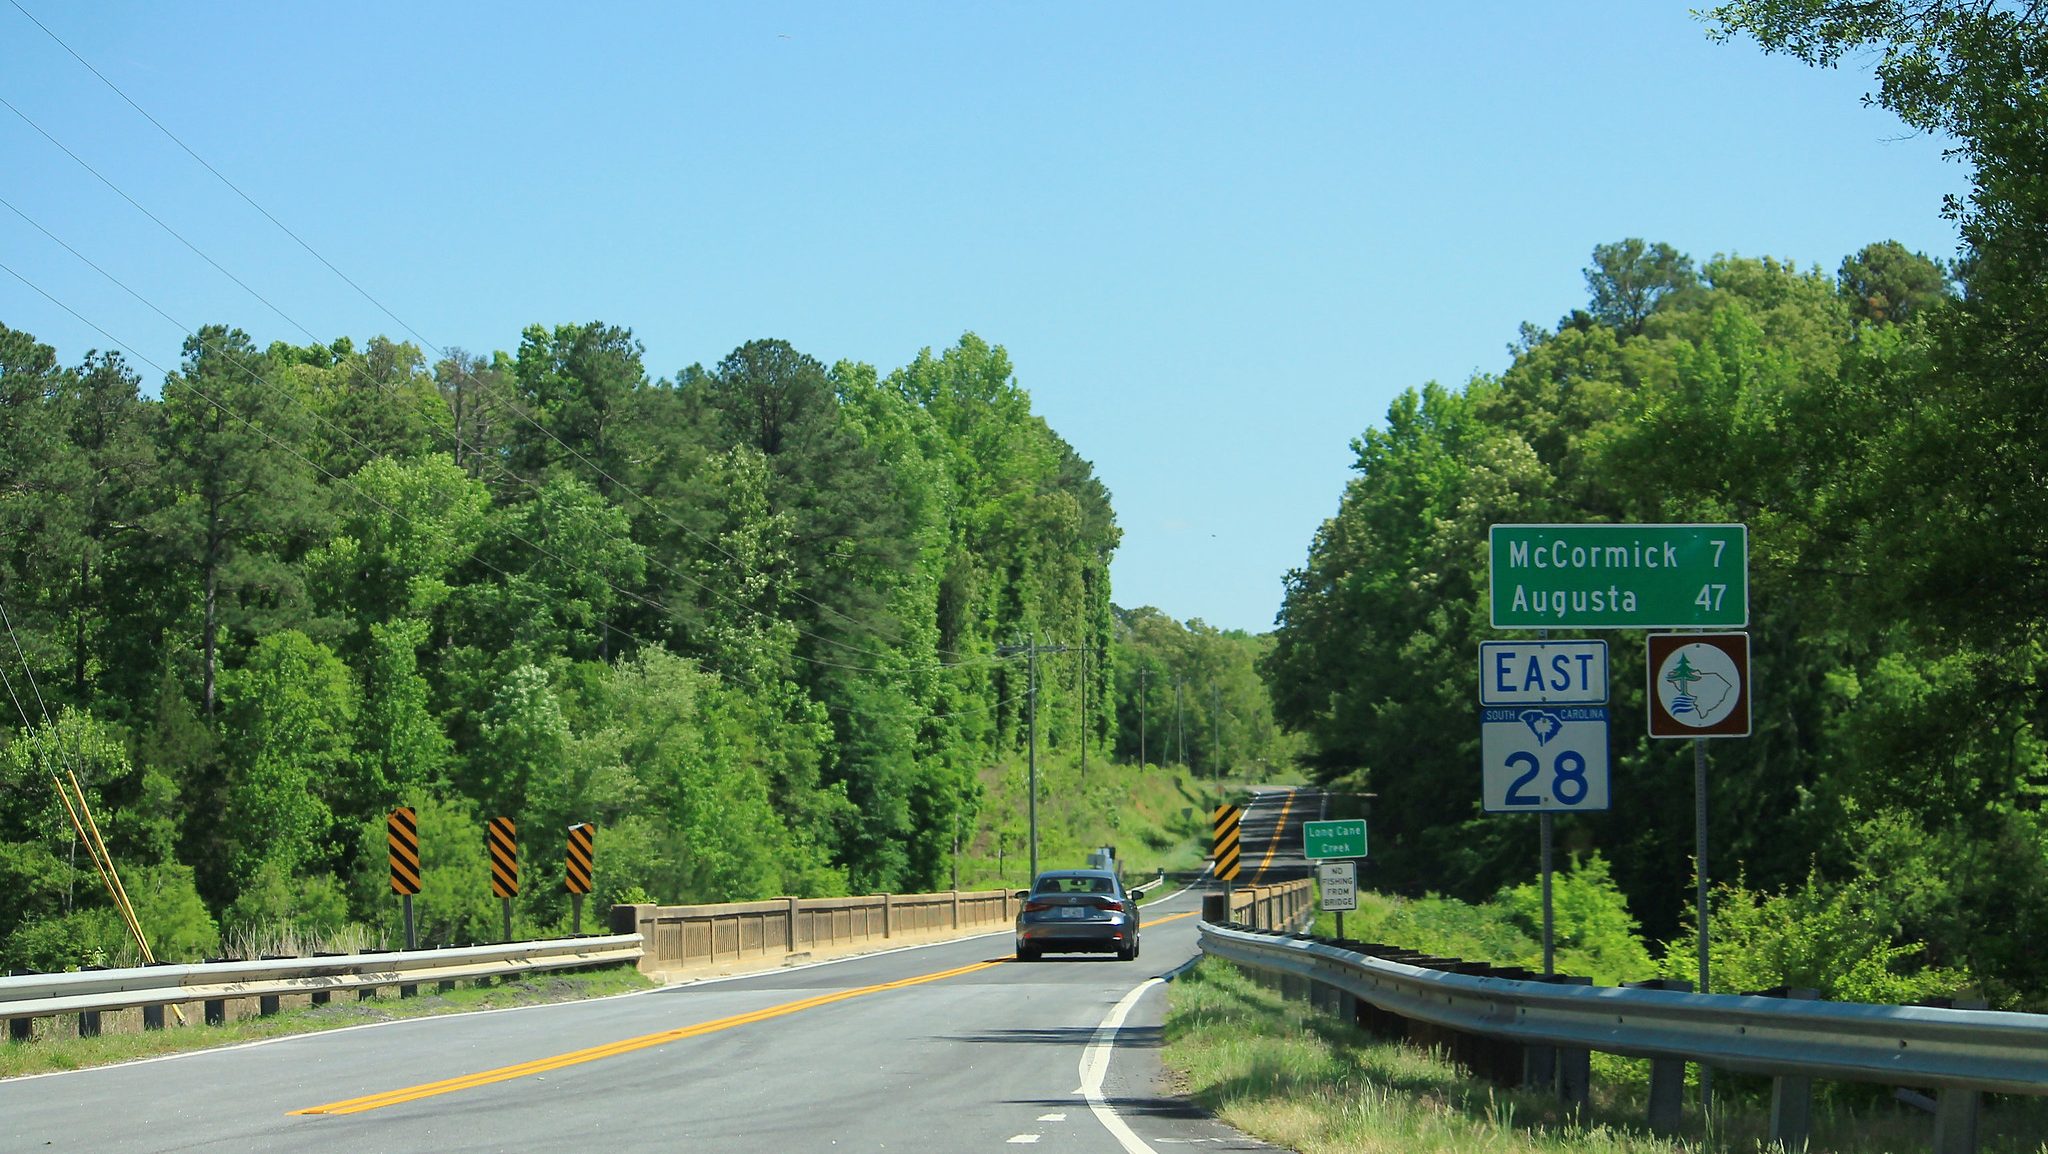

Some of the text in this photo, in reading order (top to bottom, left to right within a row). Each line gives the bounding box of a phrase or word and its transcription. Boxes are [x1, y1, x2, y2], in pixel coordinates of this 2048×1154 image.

[1510, 540, 1726, 568] McCormick 7
[1511, 584, 1727, 619] Augusta 47
[1496, 652, 1594, 692] EAST
[1486, 709, 1604, 720] SOUTH CAROLINA
[1504, 750, 1588, 806] 28
[1308, 826, 1361, 838] Long Cane
[1321, 843, 1350, 853] Creek
[1332, 867, 1343, 875] NO
[1322, 877, 1353, 886] FISHING
[1327, 888, 1349, 896] FROM
[1324, 898, 1353, 907] BRIDGE
